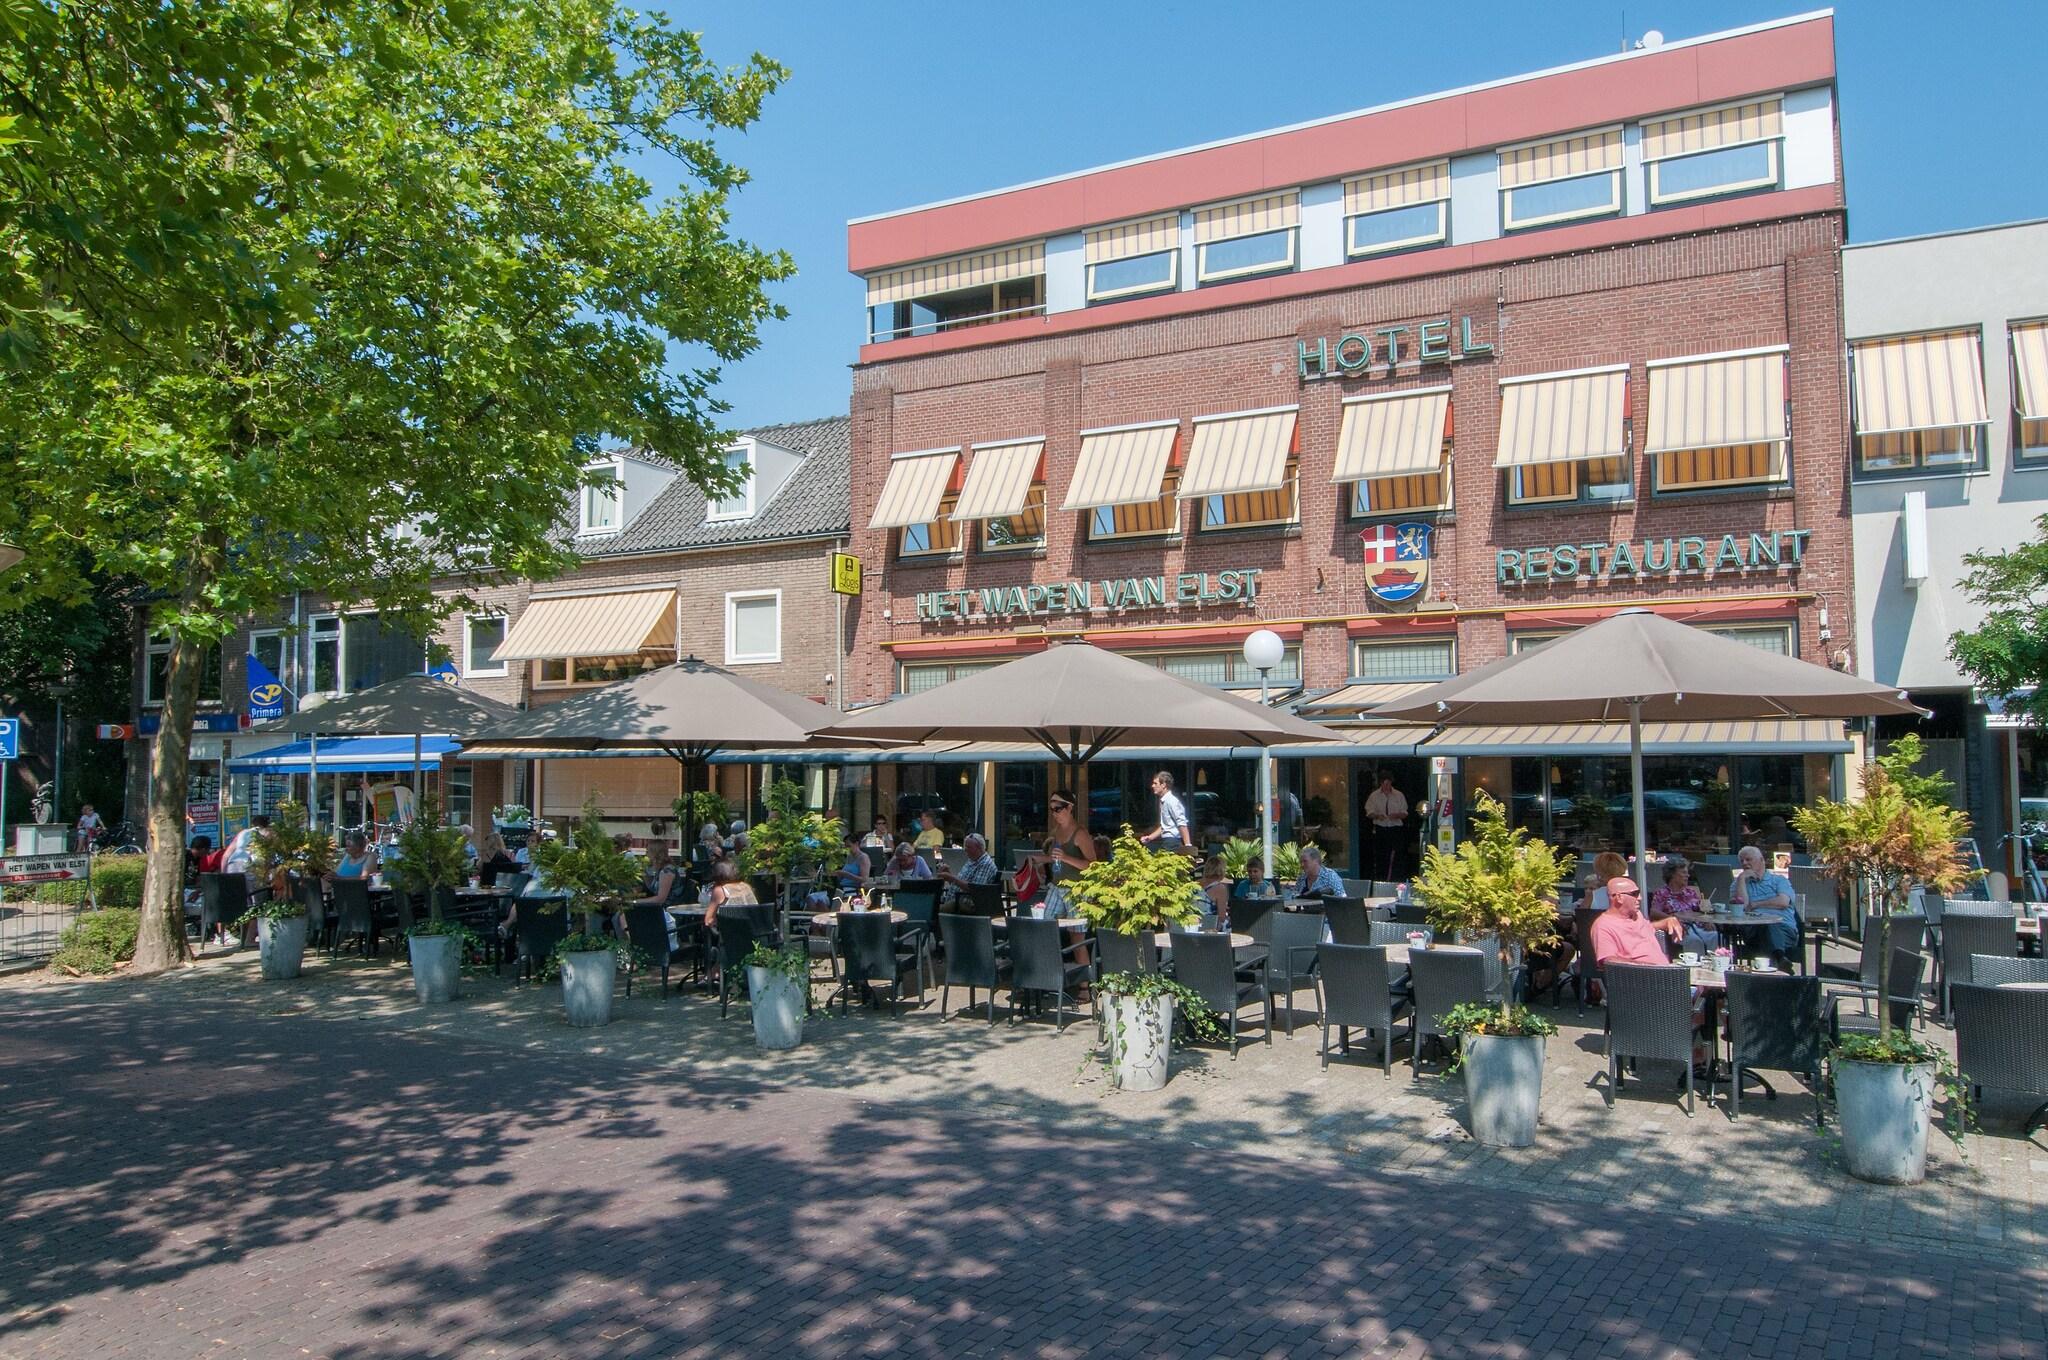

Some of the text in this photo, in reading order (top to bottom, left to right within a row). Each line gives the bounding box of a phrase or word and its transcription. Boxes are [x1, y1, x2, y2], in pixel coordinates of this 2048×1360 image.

[1298, 316, 1493, 376] HOTEL
[1496, 528, 1811, 581] RESTAURANT
[916, 568, 1262, 617] HET WAPEN VAN ELST
[251, 707, 282, 718] Primera
[8, 864, 23, 873] HET
[25, 862, 51, 872] WAPEN
[53, 861, 67, 869] VAN
[69, 860, 86, 868] ELST
